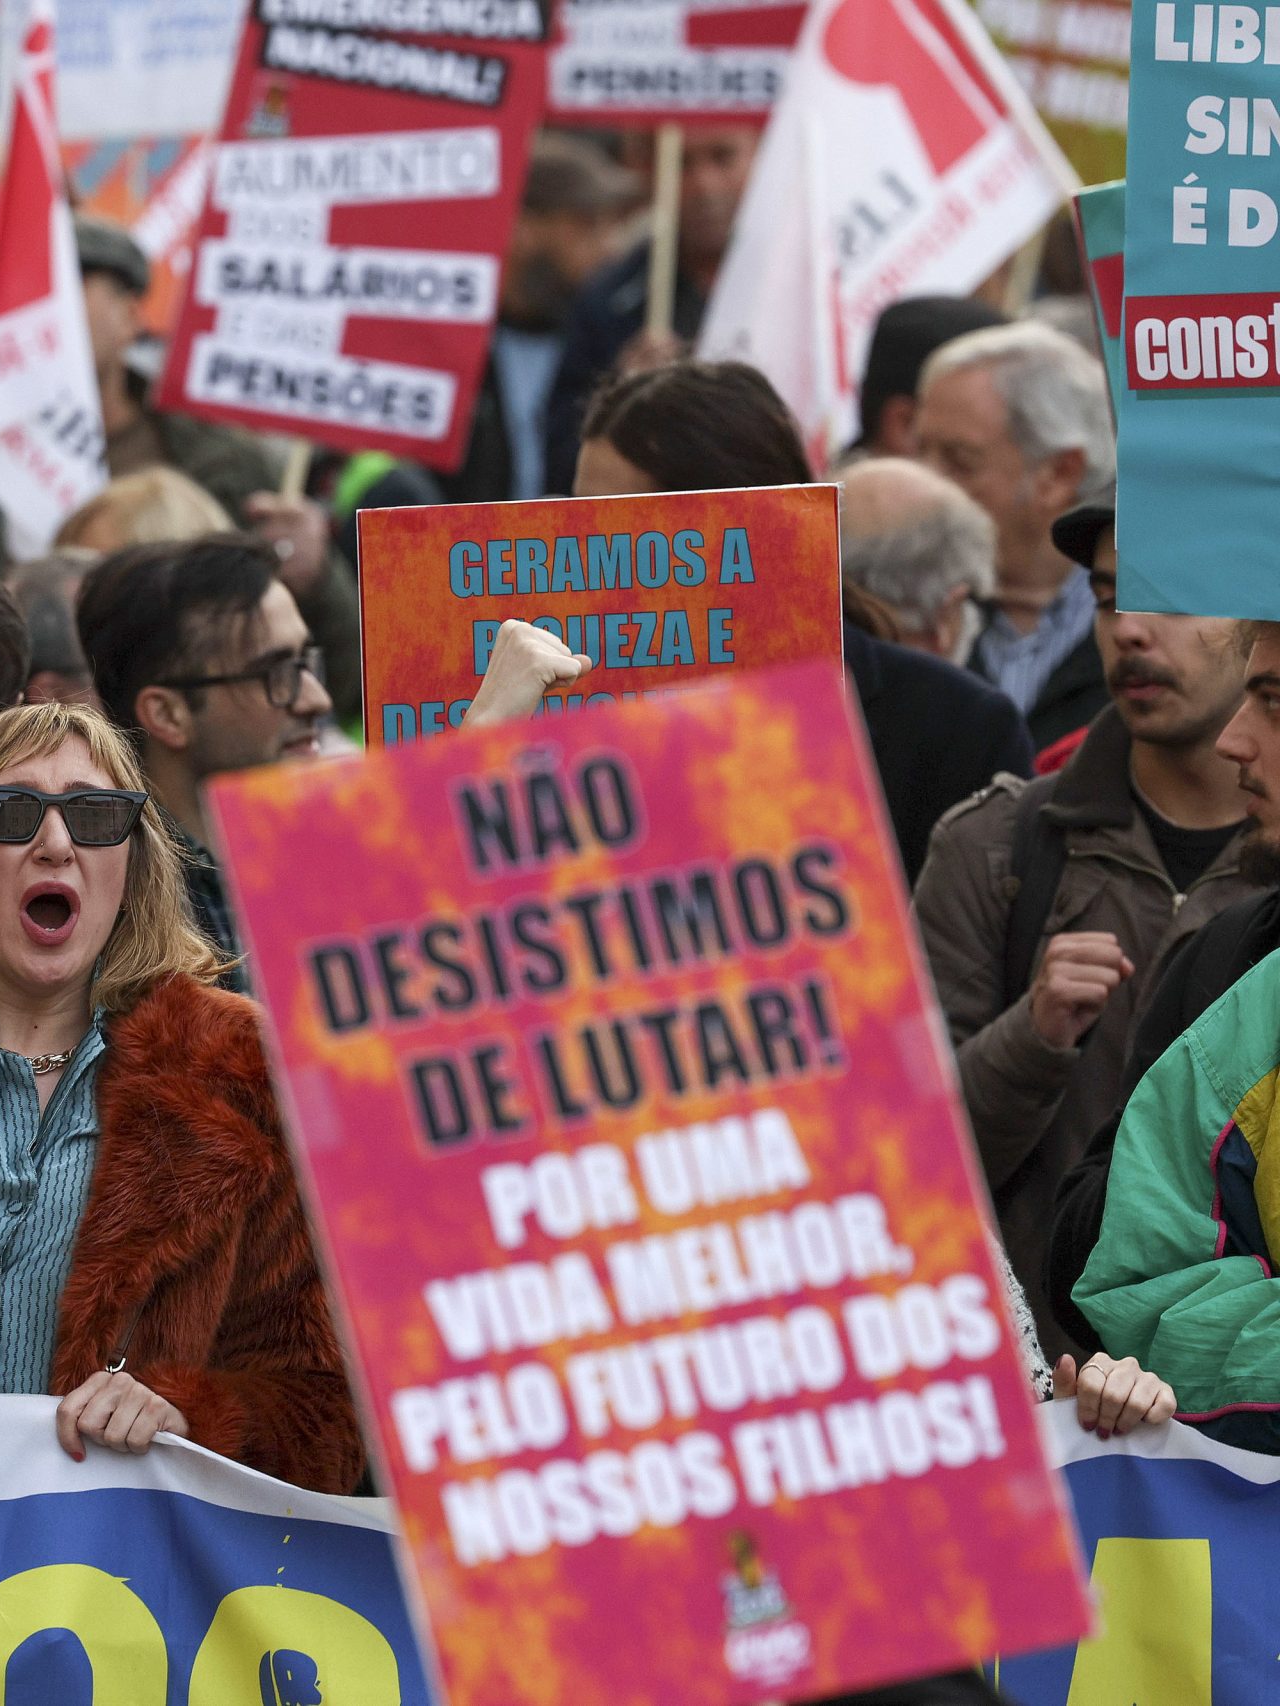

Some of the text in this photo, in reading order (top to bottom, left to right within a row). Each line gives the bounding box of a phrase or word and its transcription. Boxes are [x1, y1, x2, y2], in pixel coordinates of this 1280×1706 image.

[268, 26, 504, 105] NACIONAL!
[223, 137, 489, 191] AUMENTO
[239, 209, 312, 242] DOS
[1172, 172, 1208, 245] É
[222, 250, 479, 305] SALÁRIOS
[206, 354, 438, 421] PENSÕES
[448, 527, 755, 599] GERAMOS A
[473, 608, 736, 676] RUEZA E
[457, 749, 639, 872] NÃO
[311, 847, 853, 1036] DESISTIMOS
[410, 978, 844, 1146] DE LUTAR!
[481, 1107, 811, 1249] POR UMA
[425, 1193, 914, 1361] VIDA MELHOR,
[391, 1274, 1000, 1474] PELO FUTURO DOS
[440, 1375, 1005, 1568] NOSSOS FILHOS!
